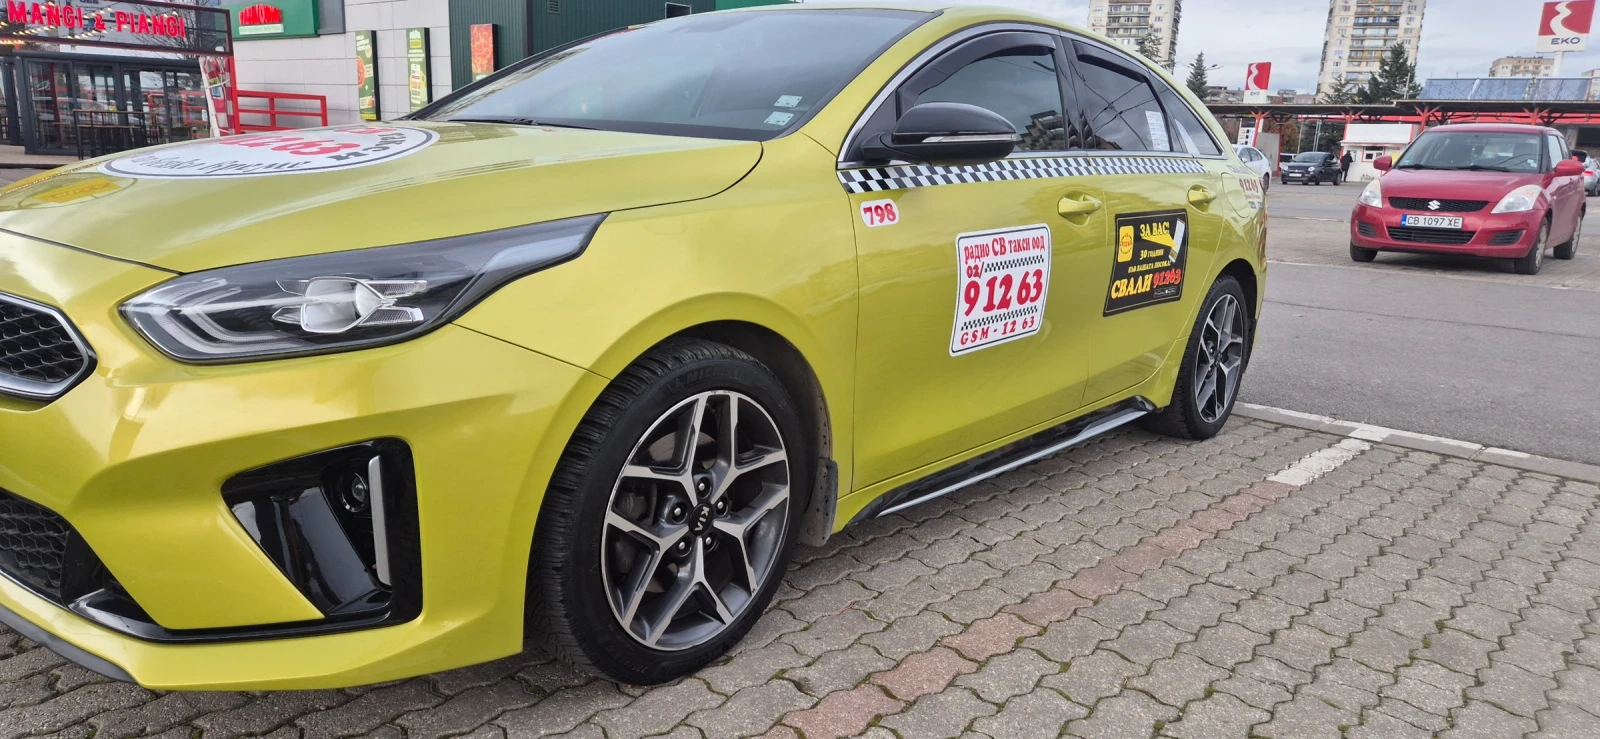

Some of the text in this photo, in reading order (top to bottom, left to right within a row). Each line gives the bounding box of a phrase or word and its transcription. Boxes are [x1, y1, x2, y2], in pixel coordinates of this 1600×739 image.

[7, 0, 187, 39] MANGI & PIANGI
[1550, 36, 1581, 45] EKO
[863, 203, 897, 226] 798
[1407, 216, 1461, 228] CB 1097 XE
[1140, 221, 1170, 238] ЗА ВАС!
[964, 235, 1045, 265] радио СВ такси оод
[1140, 249, 1148, 260] 30
[966, 261, 985, 280] 02/
[1111, 268, 1182, 299] СВАЛИ 91263
[960, 326, 990, 346] GSM
[1001, 320, 1017, 335] 12
[1021, 315, 1035, 330] 63
[694, 506, 710, 531] KIA
